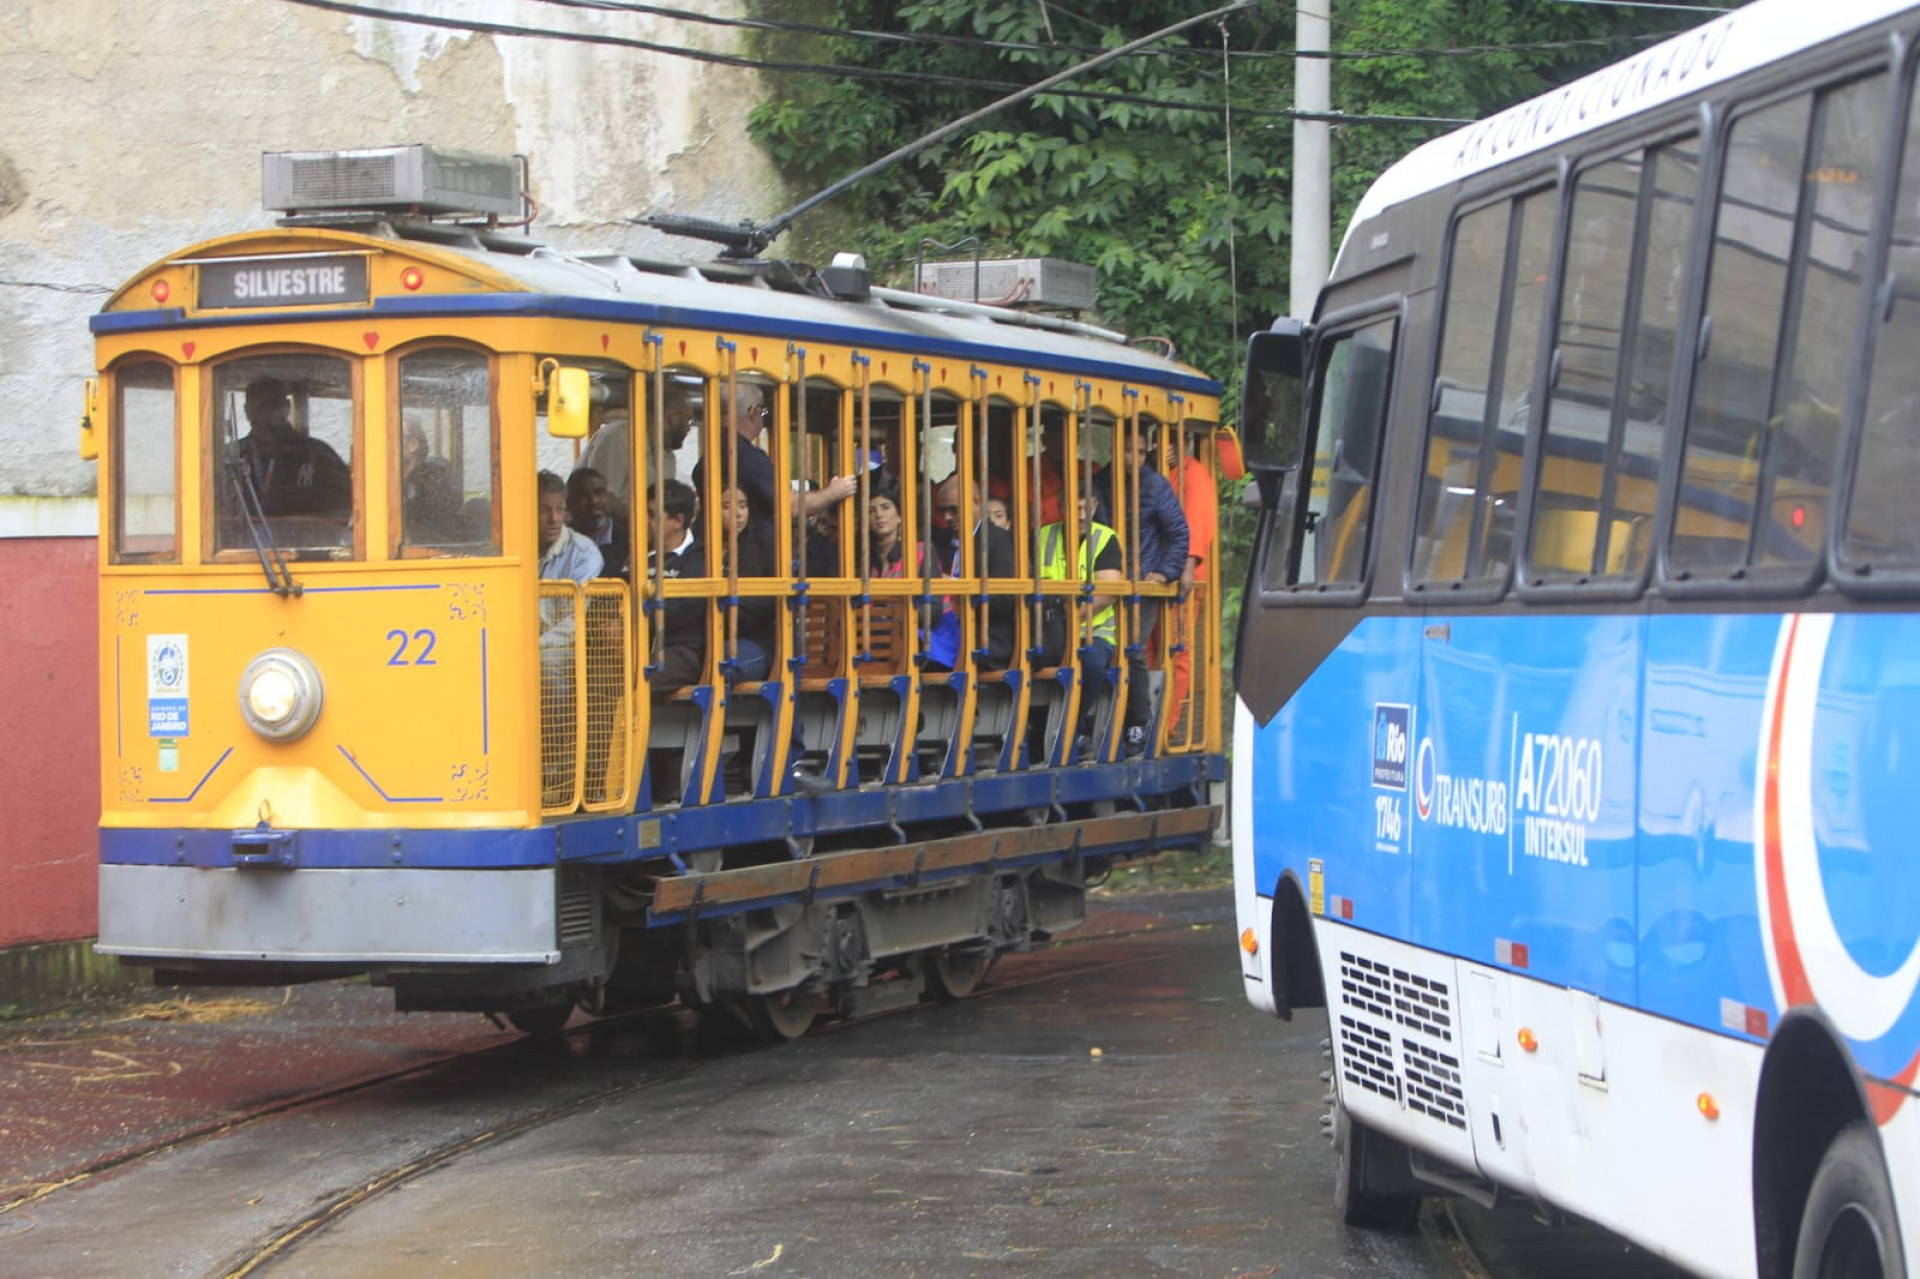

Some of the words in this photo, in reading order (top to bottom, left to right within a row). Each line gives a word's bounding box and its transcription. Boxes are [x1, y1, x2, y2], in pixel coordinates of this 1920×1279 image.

[234, 266, 346, 298] SILVESTRE
[387, 629, 437, 666] 22
[1386, 722, 1406, 764] Rio
[1516, 733, 1602, 822] A72060
[1375, 795, 1401, 842] 1746
[1435, 774, 1507, 836] TRANSURB
[1524, 815, 1589, 867] INTERSUL
